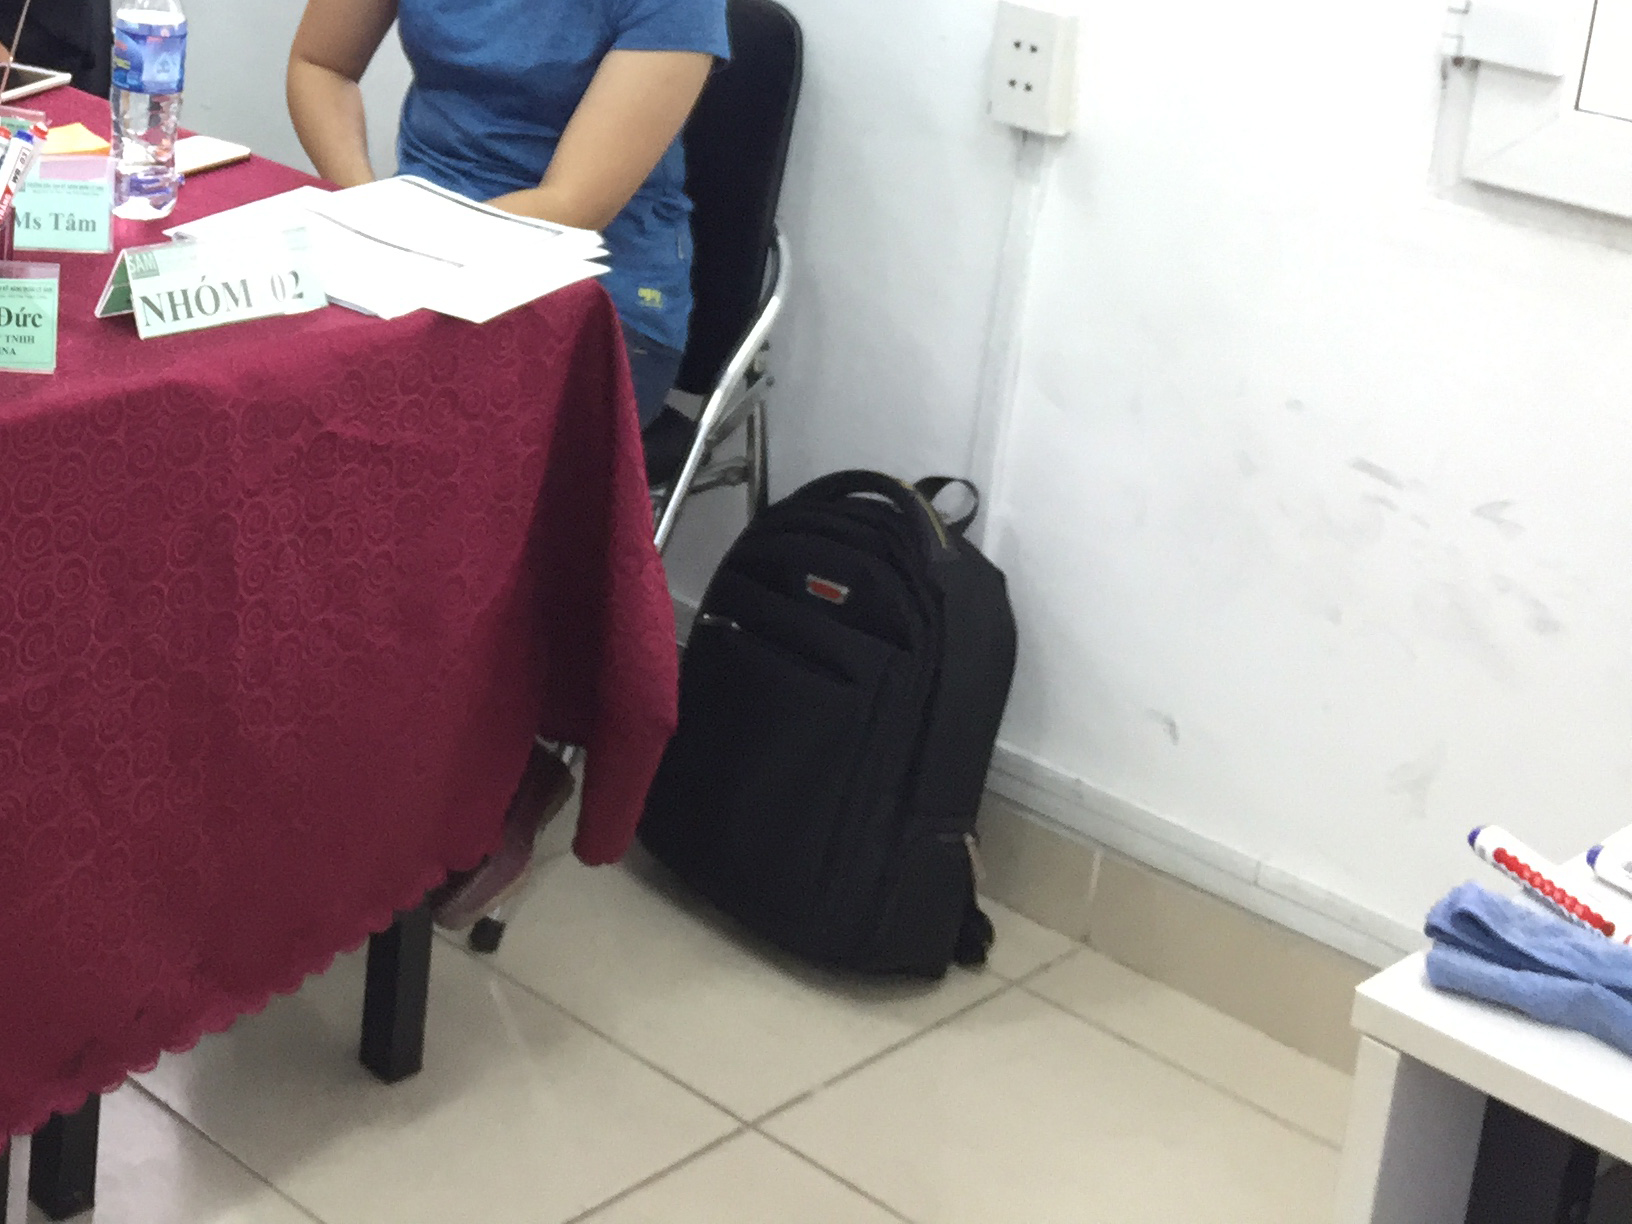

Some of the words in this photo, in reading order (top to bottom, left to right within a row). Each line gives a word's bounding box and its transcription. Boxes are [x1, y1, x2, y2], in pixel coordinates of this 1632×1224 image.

[14, 211, 42, 230] Ms
[49, 212, 97, 233] Tâm
[139, 275, 254, 327] NHÓM
[270, 270, 305, 302] 02
